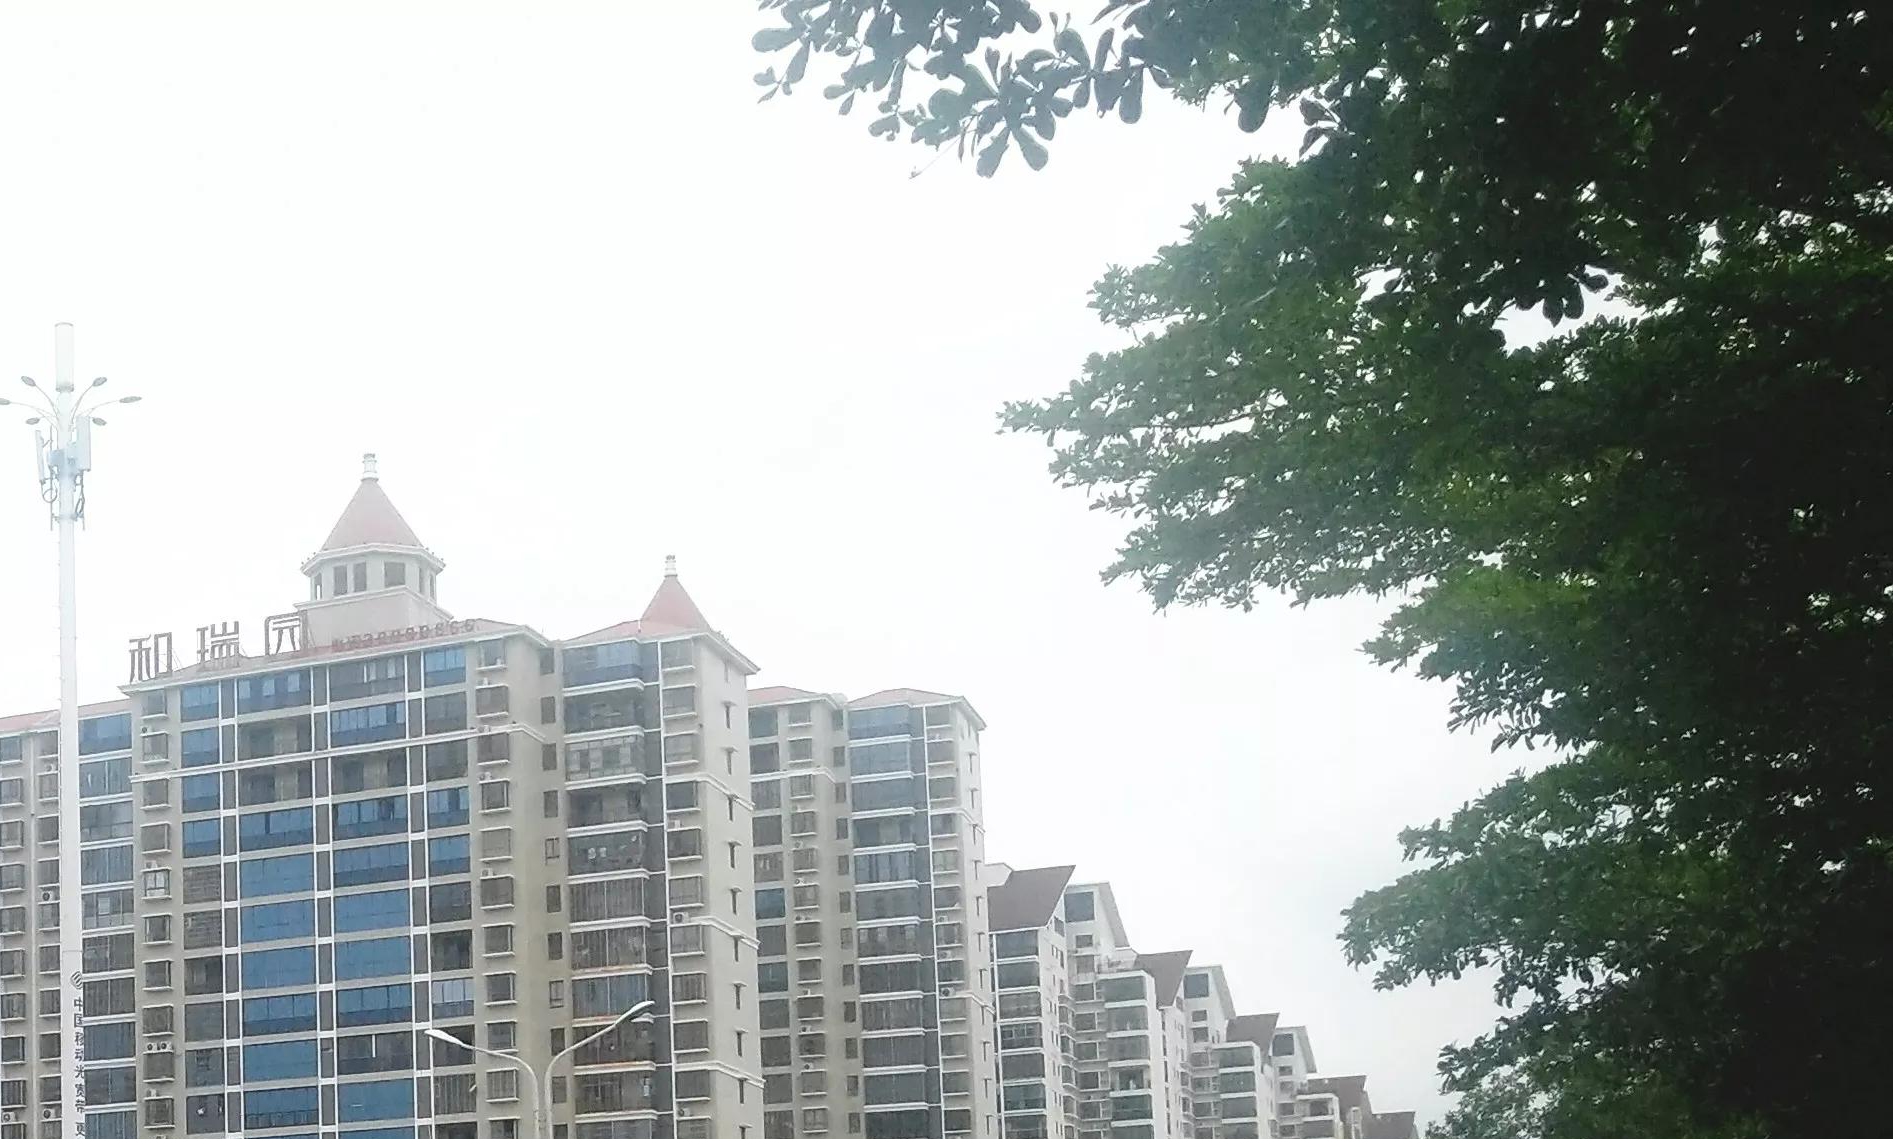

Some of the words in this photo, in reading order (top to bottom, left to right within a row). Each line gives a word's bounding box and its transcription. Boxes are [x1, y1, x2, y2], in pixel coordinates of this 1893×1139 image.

[128, 610, 308, 685] 和瑞园
[73, 996, 85, 1114] 中国移动光宽带
